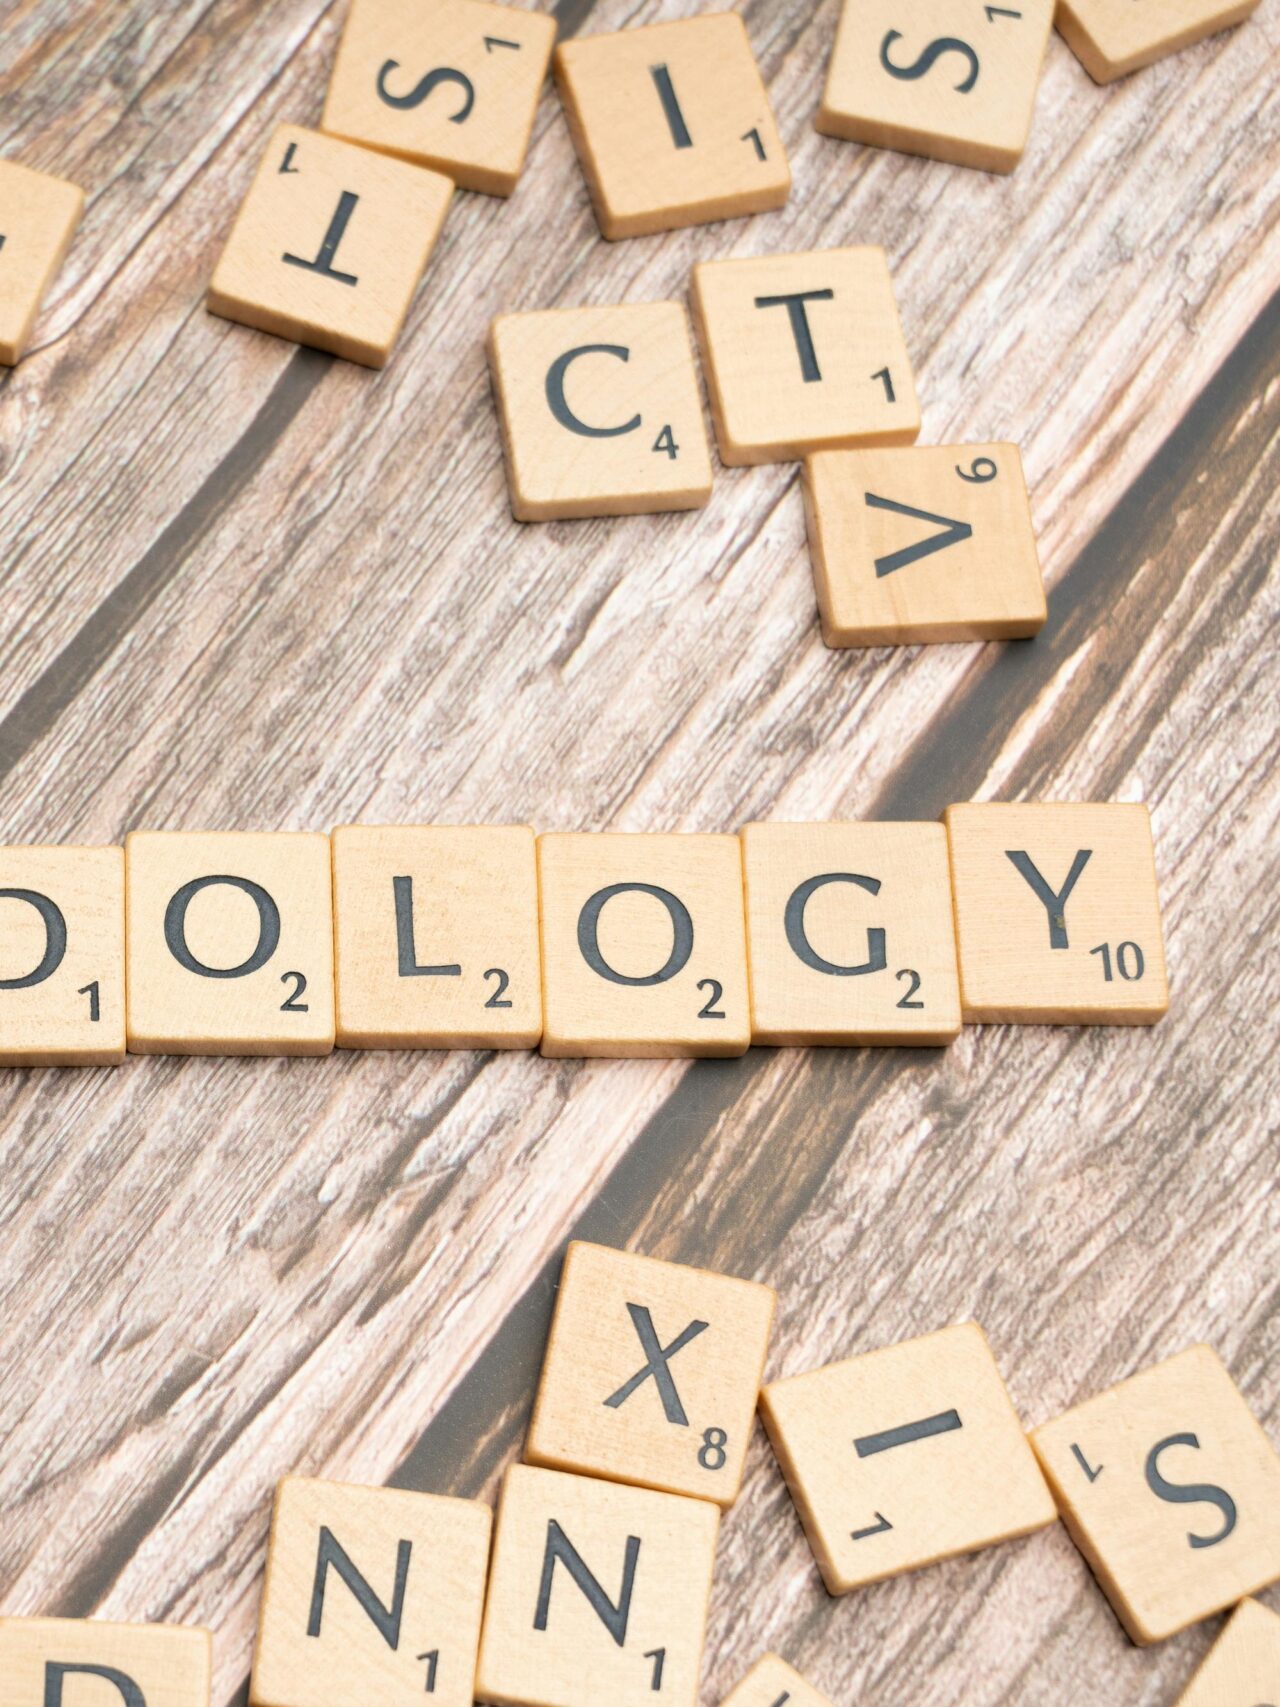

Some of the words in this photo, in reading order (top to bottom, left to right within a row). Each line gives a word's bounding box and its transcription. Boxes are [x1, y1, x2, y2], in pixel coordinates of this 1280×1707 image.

[377, 59, 474, 123] S
[484, 37, 520, 52] 1
[880, 30, 979, 93] S
[985, 6, 1021, 21] 1
[652, 64, 692, 148] I
[742, 128, 766, 160] 1
[279, 143, 298, 173] 1
[282, 191, 359, 286] T
[755, 289, 833, 382] T
[872, 367, 895, 402] 1
[545, 344, 641, 437] C
[653, 425, 679, 459] 4
[865, 492, 972, 578] V
[956, 458, 997, 483] 6
[78, 981, 99, 1021] 1
[281, 972, 308, 1012] 2
[484, 968, 512, 1008] 2
[697, 979, 725, 1018] 2
[896, 969, 924, 1008] 2
[1090, 942, 1144, 981] 10
[603, 1302, 709, 1426] X
[698, 1427, 727, 1470] 8
[853, 1409, 962, 1458] I
[1071, 1444, 1103, 1483] 1
[851, 1512, 893, 1540] 1
[1145, 1433, 1237, 1548] S
[307, 1526, 412, 1651] N
[417, 1650, 438, 1692] 1
[533, 1519, 641, 1647] N
[644, 1648, 665, 1691] 1
